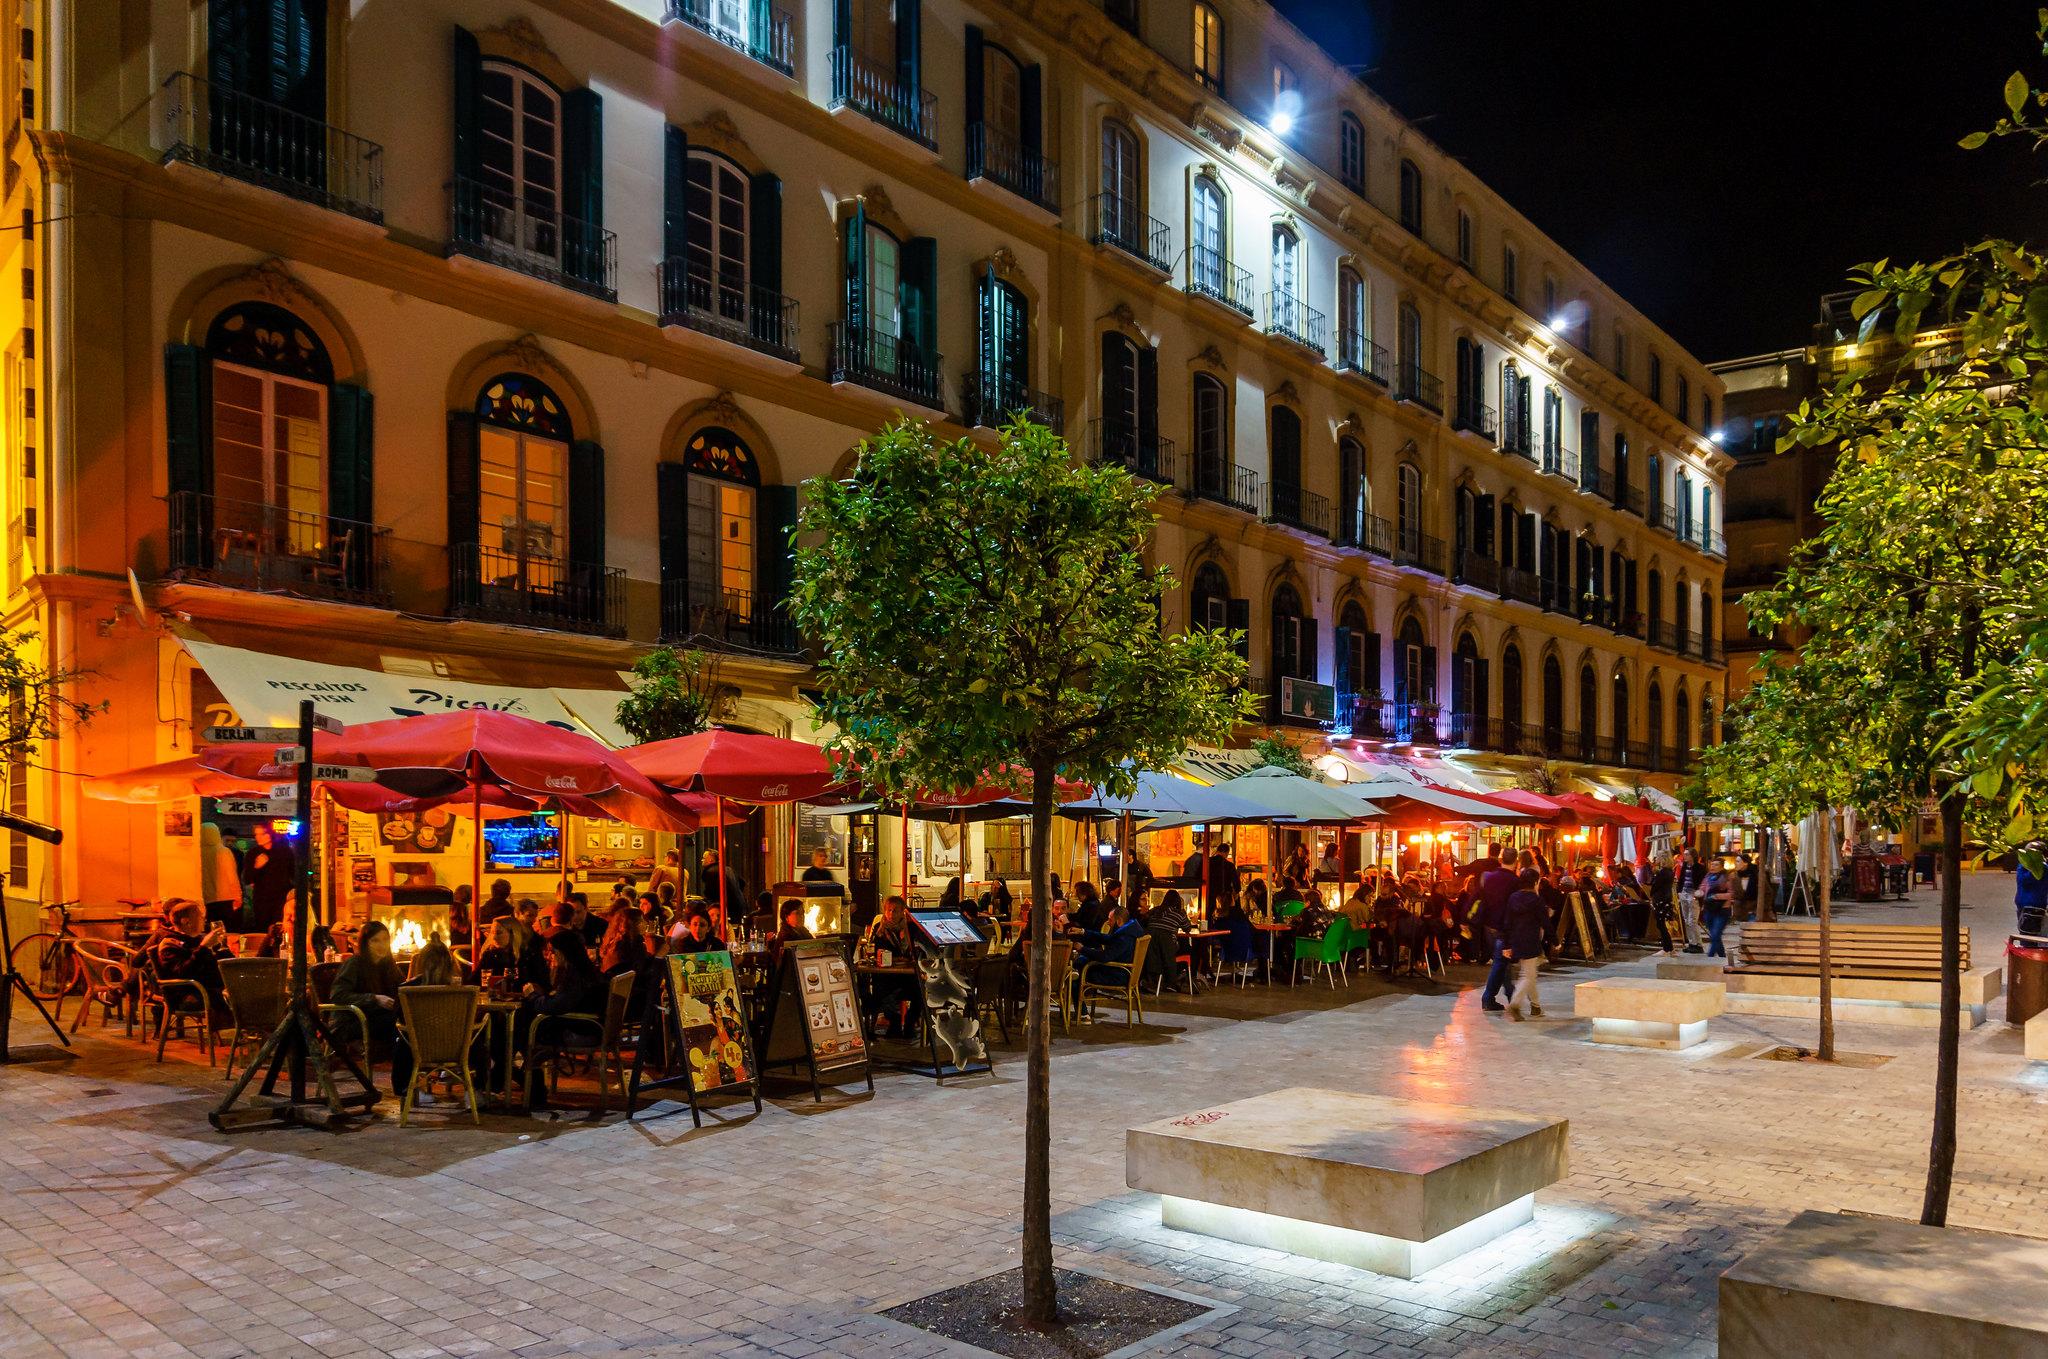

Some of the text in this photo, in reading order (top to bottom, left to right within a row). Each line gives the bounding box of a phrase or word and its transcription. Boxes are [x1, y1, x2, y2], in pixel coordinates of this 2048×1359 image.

[266, 680, 367, 692] PESCAÍTOS
[311, 694, 354, 703] FISH
[317, 767, 349, 779] ROMA
[761, 783, 789, 798] Coca-Cola
[228, 802, 268, 813] 北京市
